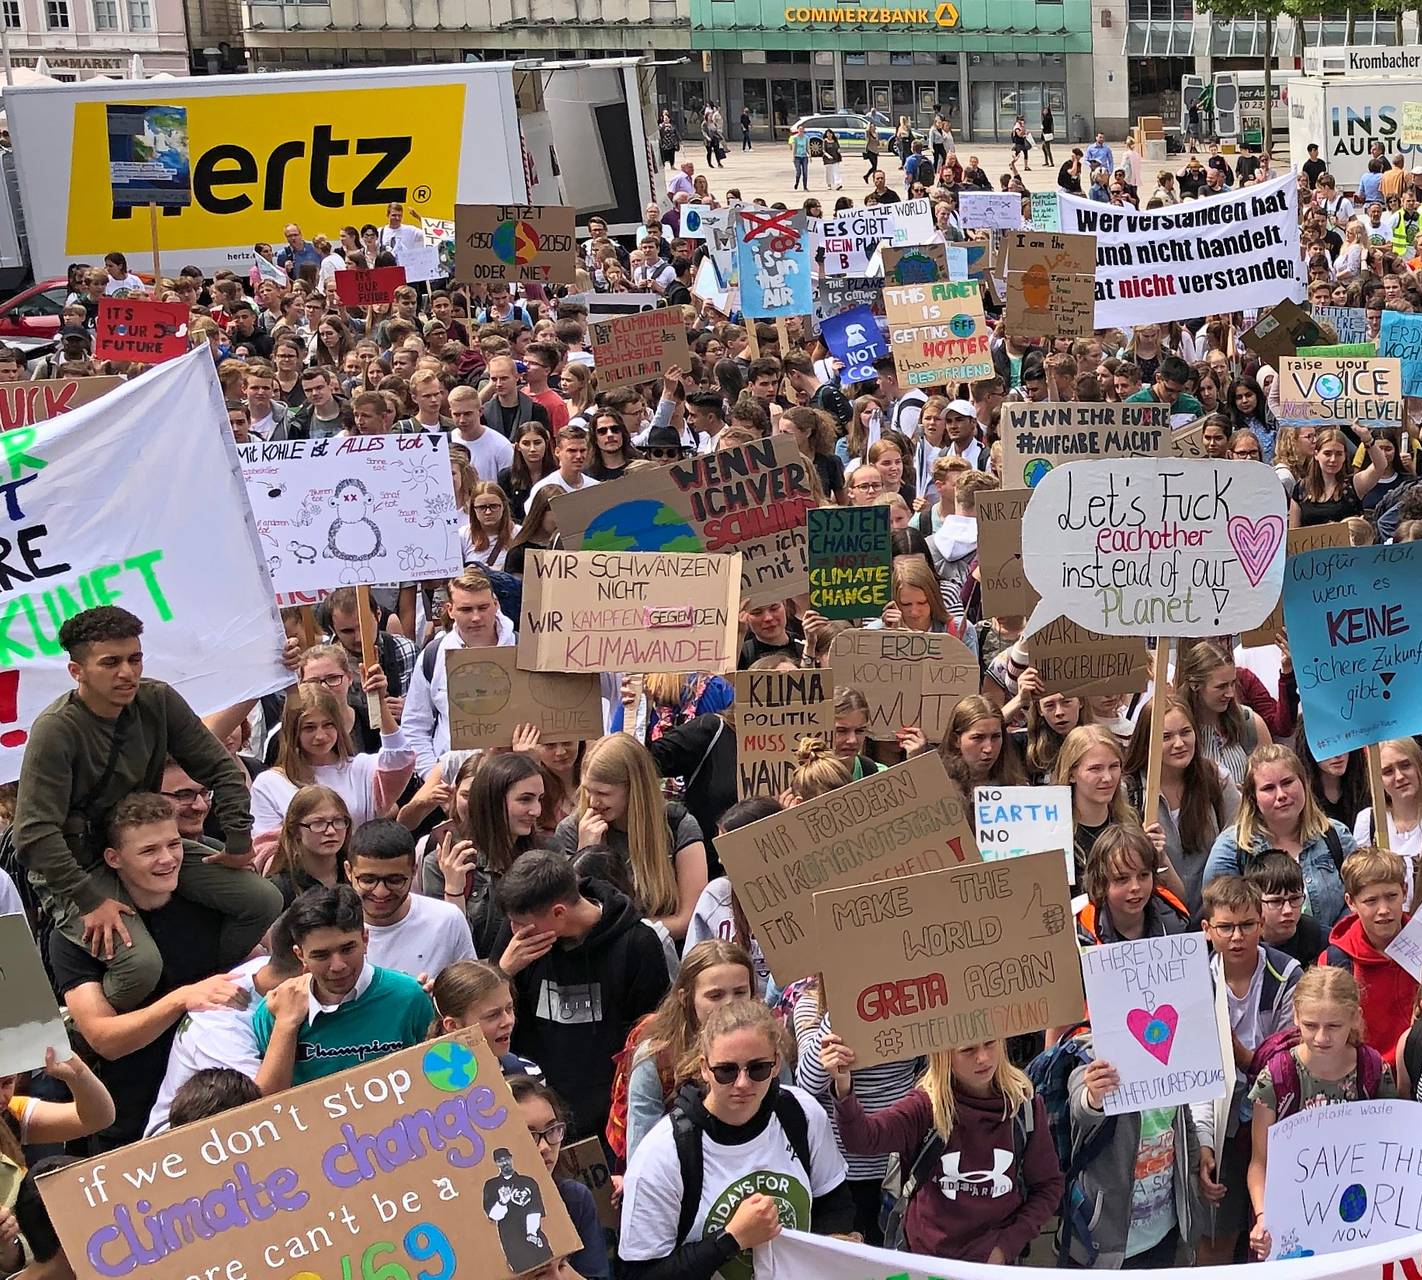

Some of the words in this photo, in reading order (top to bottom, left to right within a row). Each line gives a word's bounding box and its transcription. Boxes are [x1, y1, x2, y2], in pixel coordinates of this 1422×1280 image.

[785, 8, 929, 25] COMMERZBANK
[1349, 52, 1421, 72] Krombacher
[497, 205, 546, 222] JETZT
[895, 200, 927, 217] WORLD
[1076, 208, 1124, 232] Wer
[1127, 184, 1247, 232] verstanden
[1252, 189, 1289, 215] hat
[824, 222, 846, 237] ES
[852, 217, 888, 236] GIBT
[466, 233, 493, 250] 1950
[539, 234, 572, 251] 2050
[825, 238, 853, 253] KEIN
[1137, 236, 1194, 265] nicht
[1199, 225, 1288, 259] handelt,
[474, 265, 506, 280] ODER
[519, 265, 551, 281] NIE!
[107, 307, 134, 321] IT'S
[102, 338, 163, 355] FUTURE
[846, 346, 877, 365] NOT
[923, 335, 989, 358] HOTTER
[899, 358, 931, 374] than
[948, 355, 969, 366] my
[1287, 359, 1323, 372] raise
[1336, 358, 1370, 380] your
[1292, 369, 1391, 400] VOICE
[261, 441, 306, 462] KOHLE
[311, 438, 330, 458] ist
[335, 437, 386, 457] ALLES
[1016, 431, 1100, 454] #AUFGABE
[1105, 430, 1160, 453] MACHT
[670, 438, 778, 492] WENN
[1058, 470, 1147, 530] Let's
[1158, 468, 1233, 523] Fuck
[807, 507, 891, 535] SYSTEM
[807, 533, 887, 555] CHANGE
[1096, 521, 1213, 555] eachother
[533, 552, 579, 581] WIR
[590, 551, 721, 579] SCHWÄNZEN
[809, 566, 890, 589] CLIMATE
[1062, 545, 1153, 590] instead
[1160, 548, 1182, 600] of
[1192, 556, 1238, 588] our
[1292, 553, 1355, 584] Wofür
[597, 581, 648, 602] NICHT,
[809, 585, 891, 607] CHANGE
[1326, 603, 1410, 648] KEINE
[565, 634, 730, 668] KLIMAWANDEL
[853, 662, 913, 683] KOCHT
[928, 666, 968, 684] VOR
[749, 674, 823, 706] KLIMA
[452, 717, 501, 738] Früher
[540, 710, 592, 731] HEUTE
[744, 712, 820, 727] POLITIK
[978, 791, 1002, 802] NO
[752, 824, 799, 864] WIR
[798, 769, 918, 843] FORDERN
[979, 804, 1059, 824] EARTH
[980, 829, 1010, 843] NO
[744, 872, 784, 914] DEN
[783, 796, 963, 898] KLIMANOTSTAND
[832, 886, 914, 931] MAKE
[951, 867, 1013, 903] THE
[903, 915, 1002, 962] WORLD
[1087, 941, 1146, 977] THERE
[1148, 938, 1164, 960] IS
[1169, 937, 1198, 959] NO
[1122, 957, 1188, 994] PLANET
[1143, 991, 1156, 1012] B
[1317, 1105, 1354, 1131] plastic
[1359, 1103, 1394, 1117] waste
[78, 1166, 109, 1209] if
[122, 1151, 188, 1190] we
[199, 1103, 310, 1166] don't
[322, 1067, 413, 1120] stop
[1294, 1143, 1367, 1184] SAVE
[85, 1160, 312, 1279] climate
[320, 1084, 509, 1189] change
[262, 1209, 361, 1269] can't
[376, 1188, 424, 1225] be
[430, 1178, 461, 1202] a
[1332, 1227, 1372, 1244] NOW
